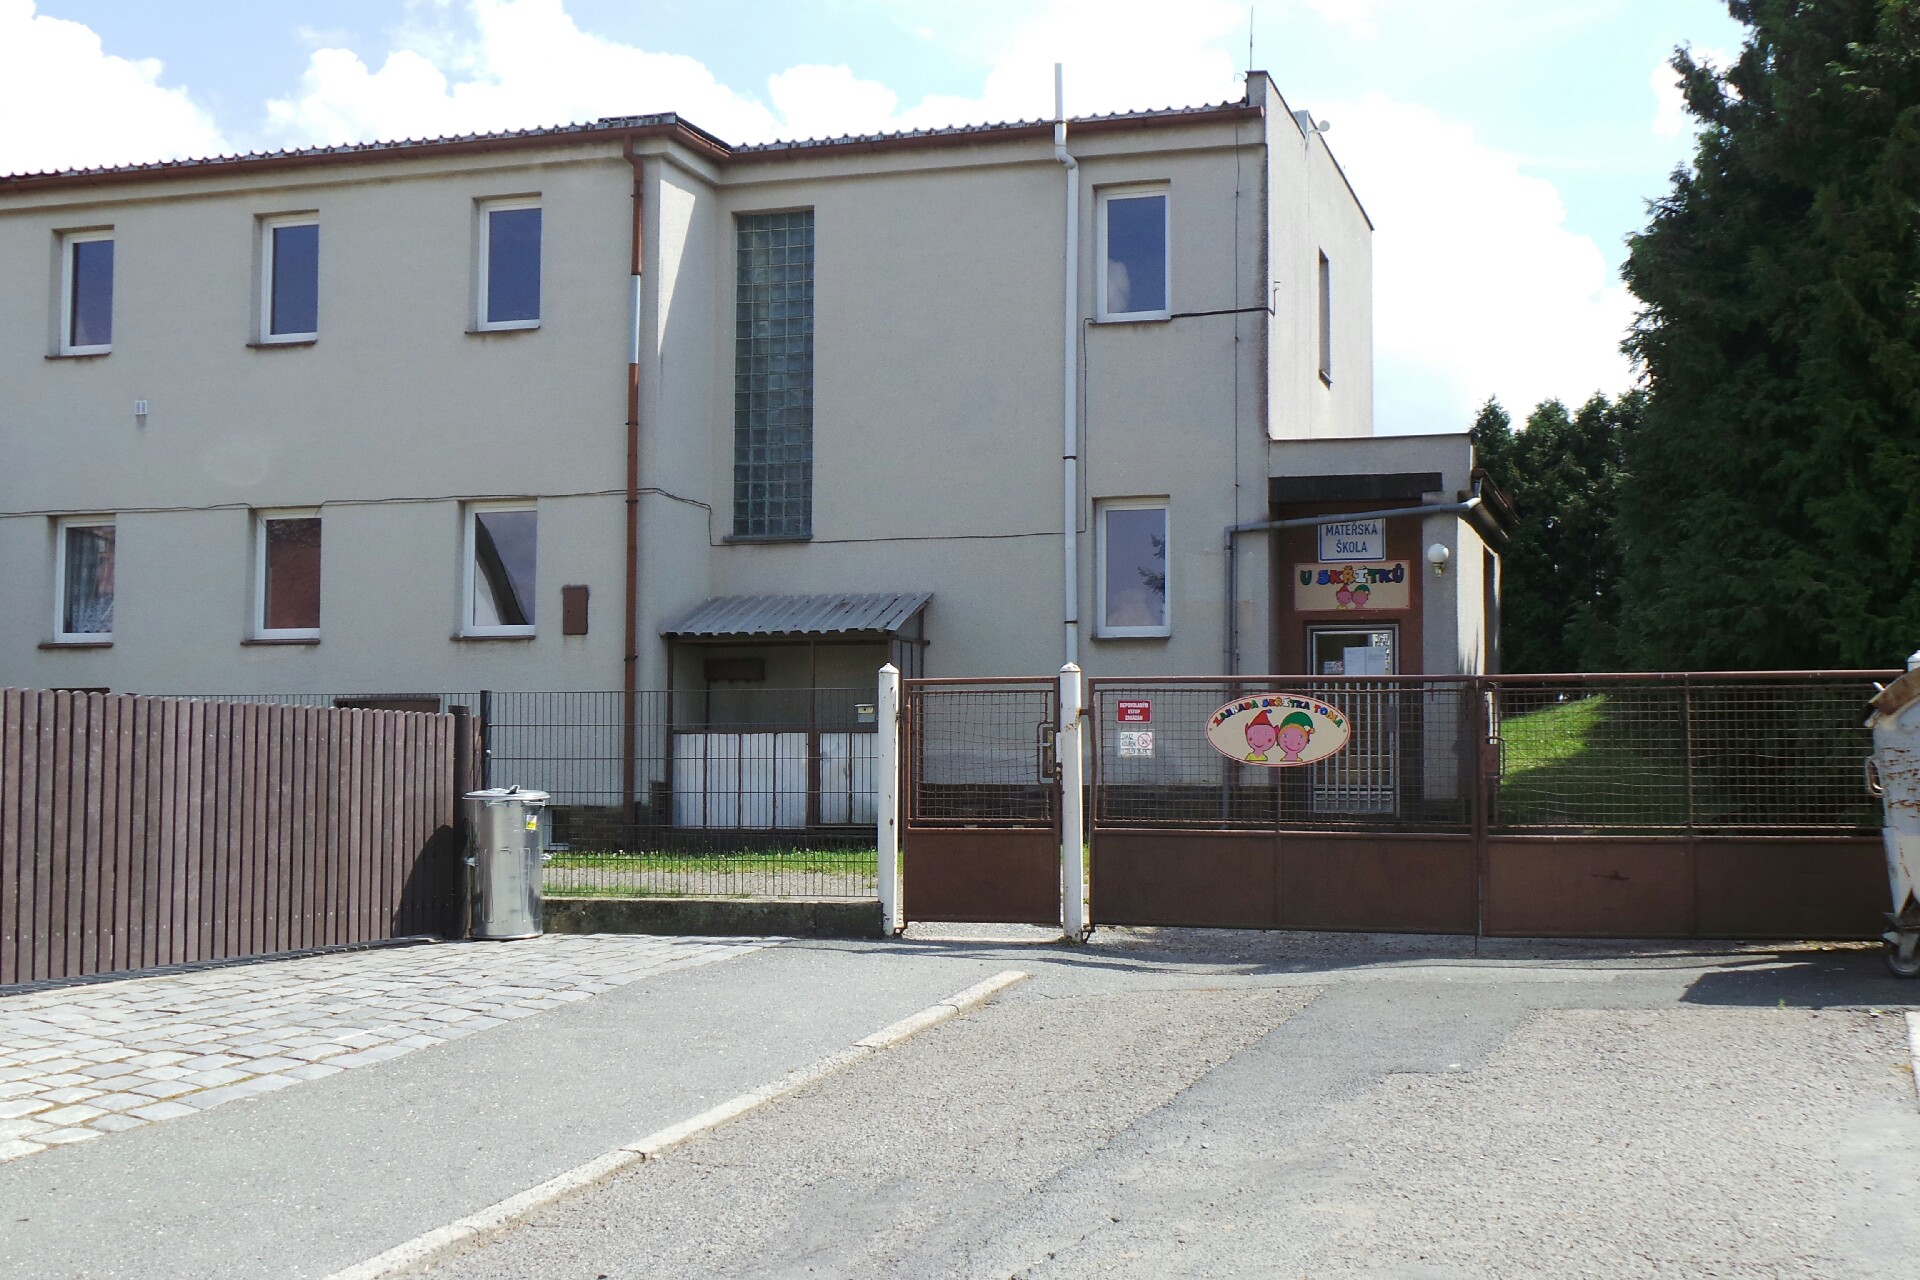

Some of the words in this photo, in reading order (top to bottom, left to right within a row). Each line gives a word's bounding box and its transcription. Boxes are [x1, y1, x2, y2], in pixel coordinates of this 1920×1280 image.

[1325, 520, 1378, 536] MATEŘSKÁ
[1336, 539, 1368, 554] ŠKOLA
[1300, 569, 1312, 586] U
[1316, 563, 1405, 586] SKŘÍTKŮ
[1213, 699, 1259, 727] ZAHRADA
[1262, 697, 1311, 711] SKŘÍTKA
[1313, 704, 1344, 728] TOMA
